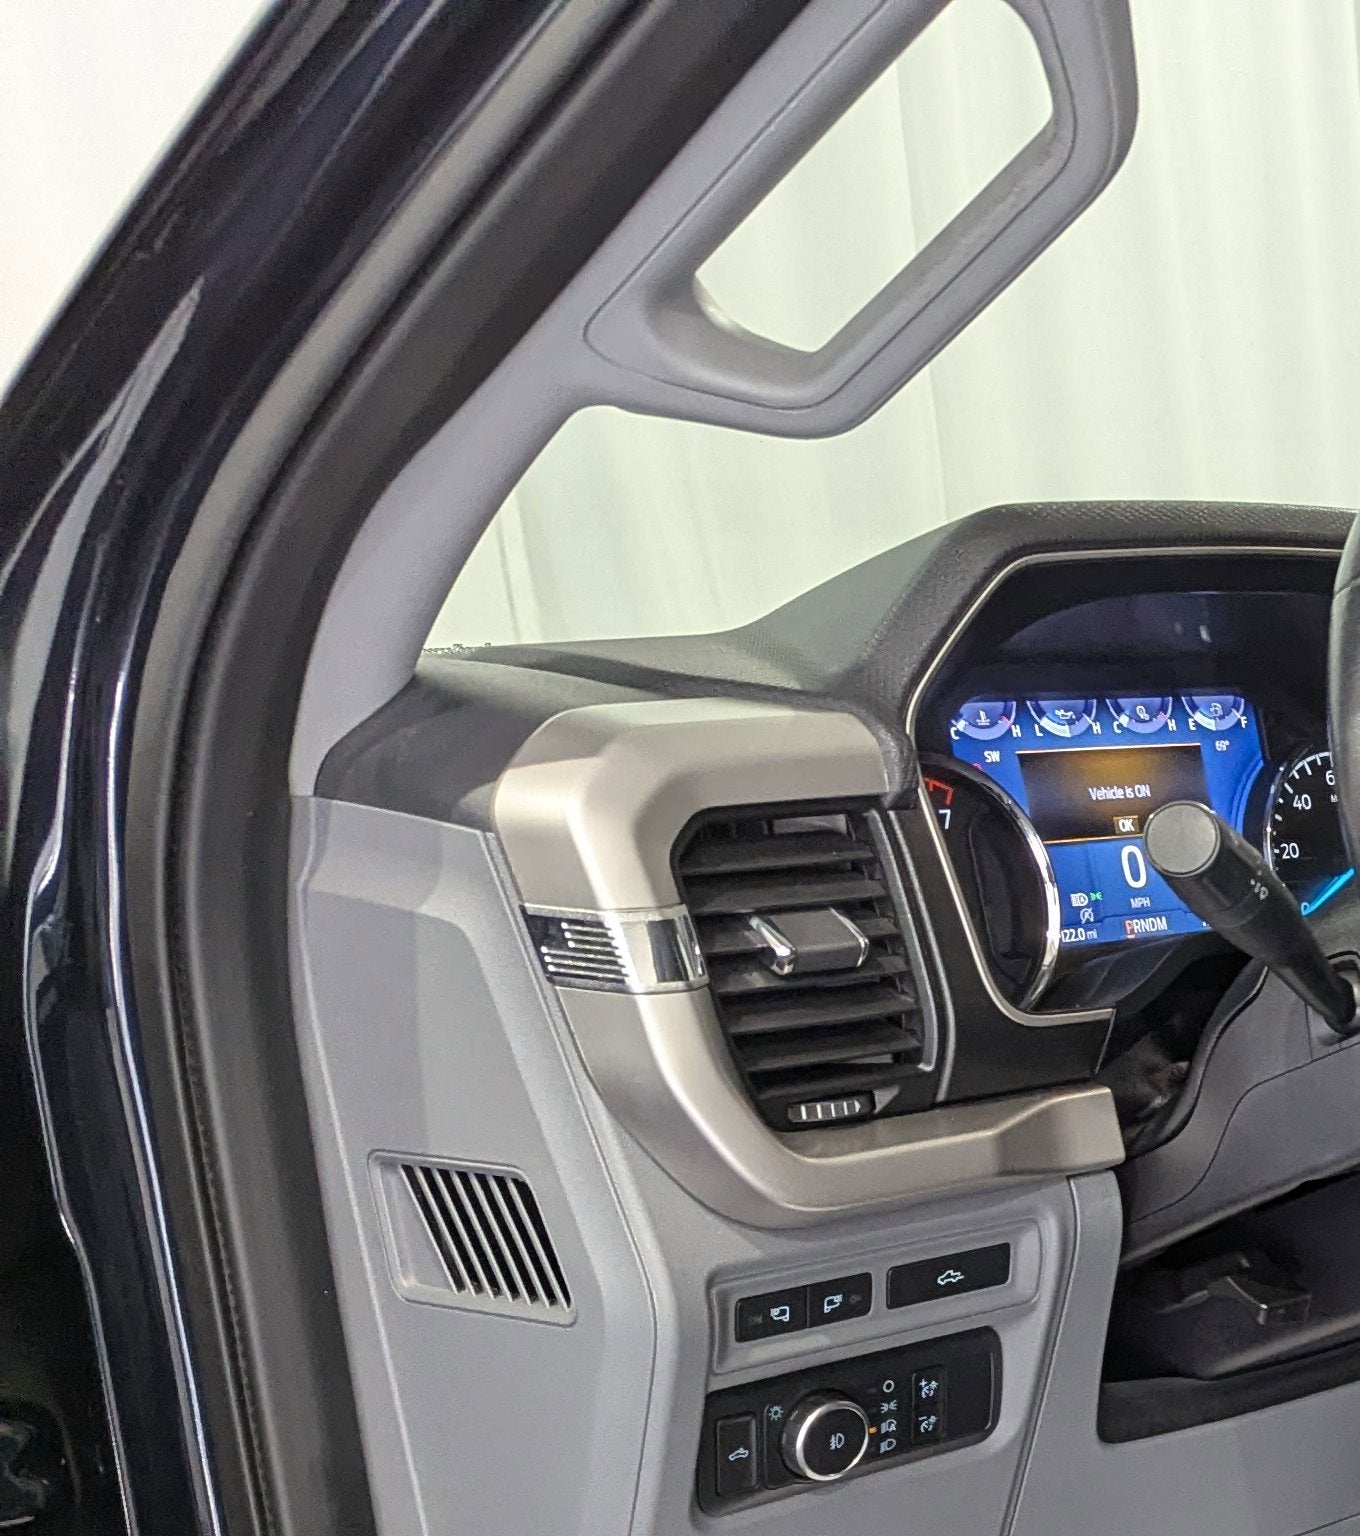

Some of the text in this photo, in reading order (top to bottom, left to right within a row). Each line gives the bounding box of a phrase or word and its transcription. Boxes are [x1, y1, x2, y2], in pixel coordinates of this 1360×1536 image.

[1012, 724, 1022, 738] H
[1034, 723, 1044, 737] L
[1093, 721, 1102, 735] H
[1113, 720, 1122, 734] C
[1168, 718, 1177, 732] H
[1188, 718, 1197, 731] E
[1240, 716, 1248, 729] F
[983, 750, 1001, 763] SW
[1088, 784, 1151, 801] Vehicle is ON
[1292, 793, 1312, 811] 40
[938, 808, 952, 830] 7
[1118, 818, 1136, 833] OK
[1280, 842, 1300, 860] 20
[1121, 844, 1148, 889] 0
[1130, 896, 1151, 909] MPH
